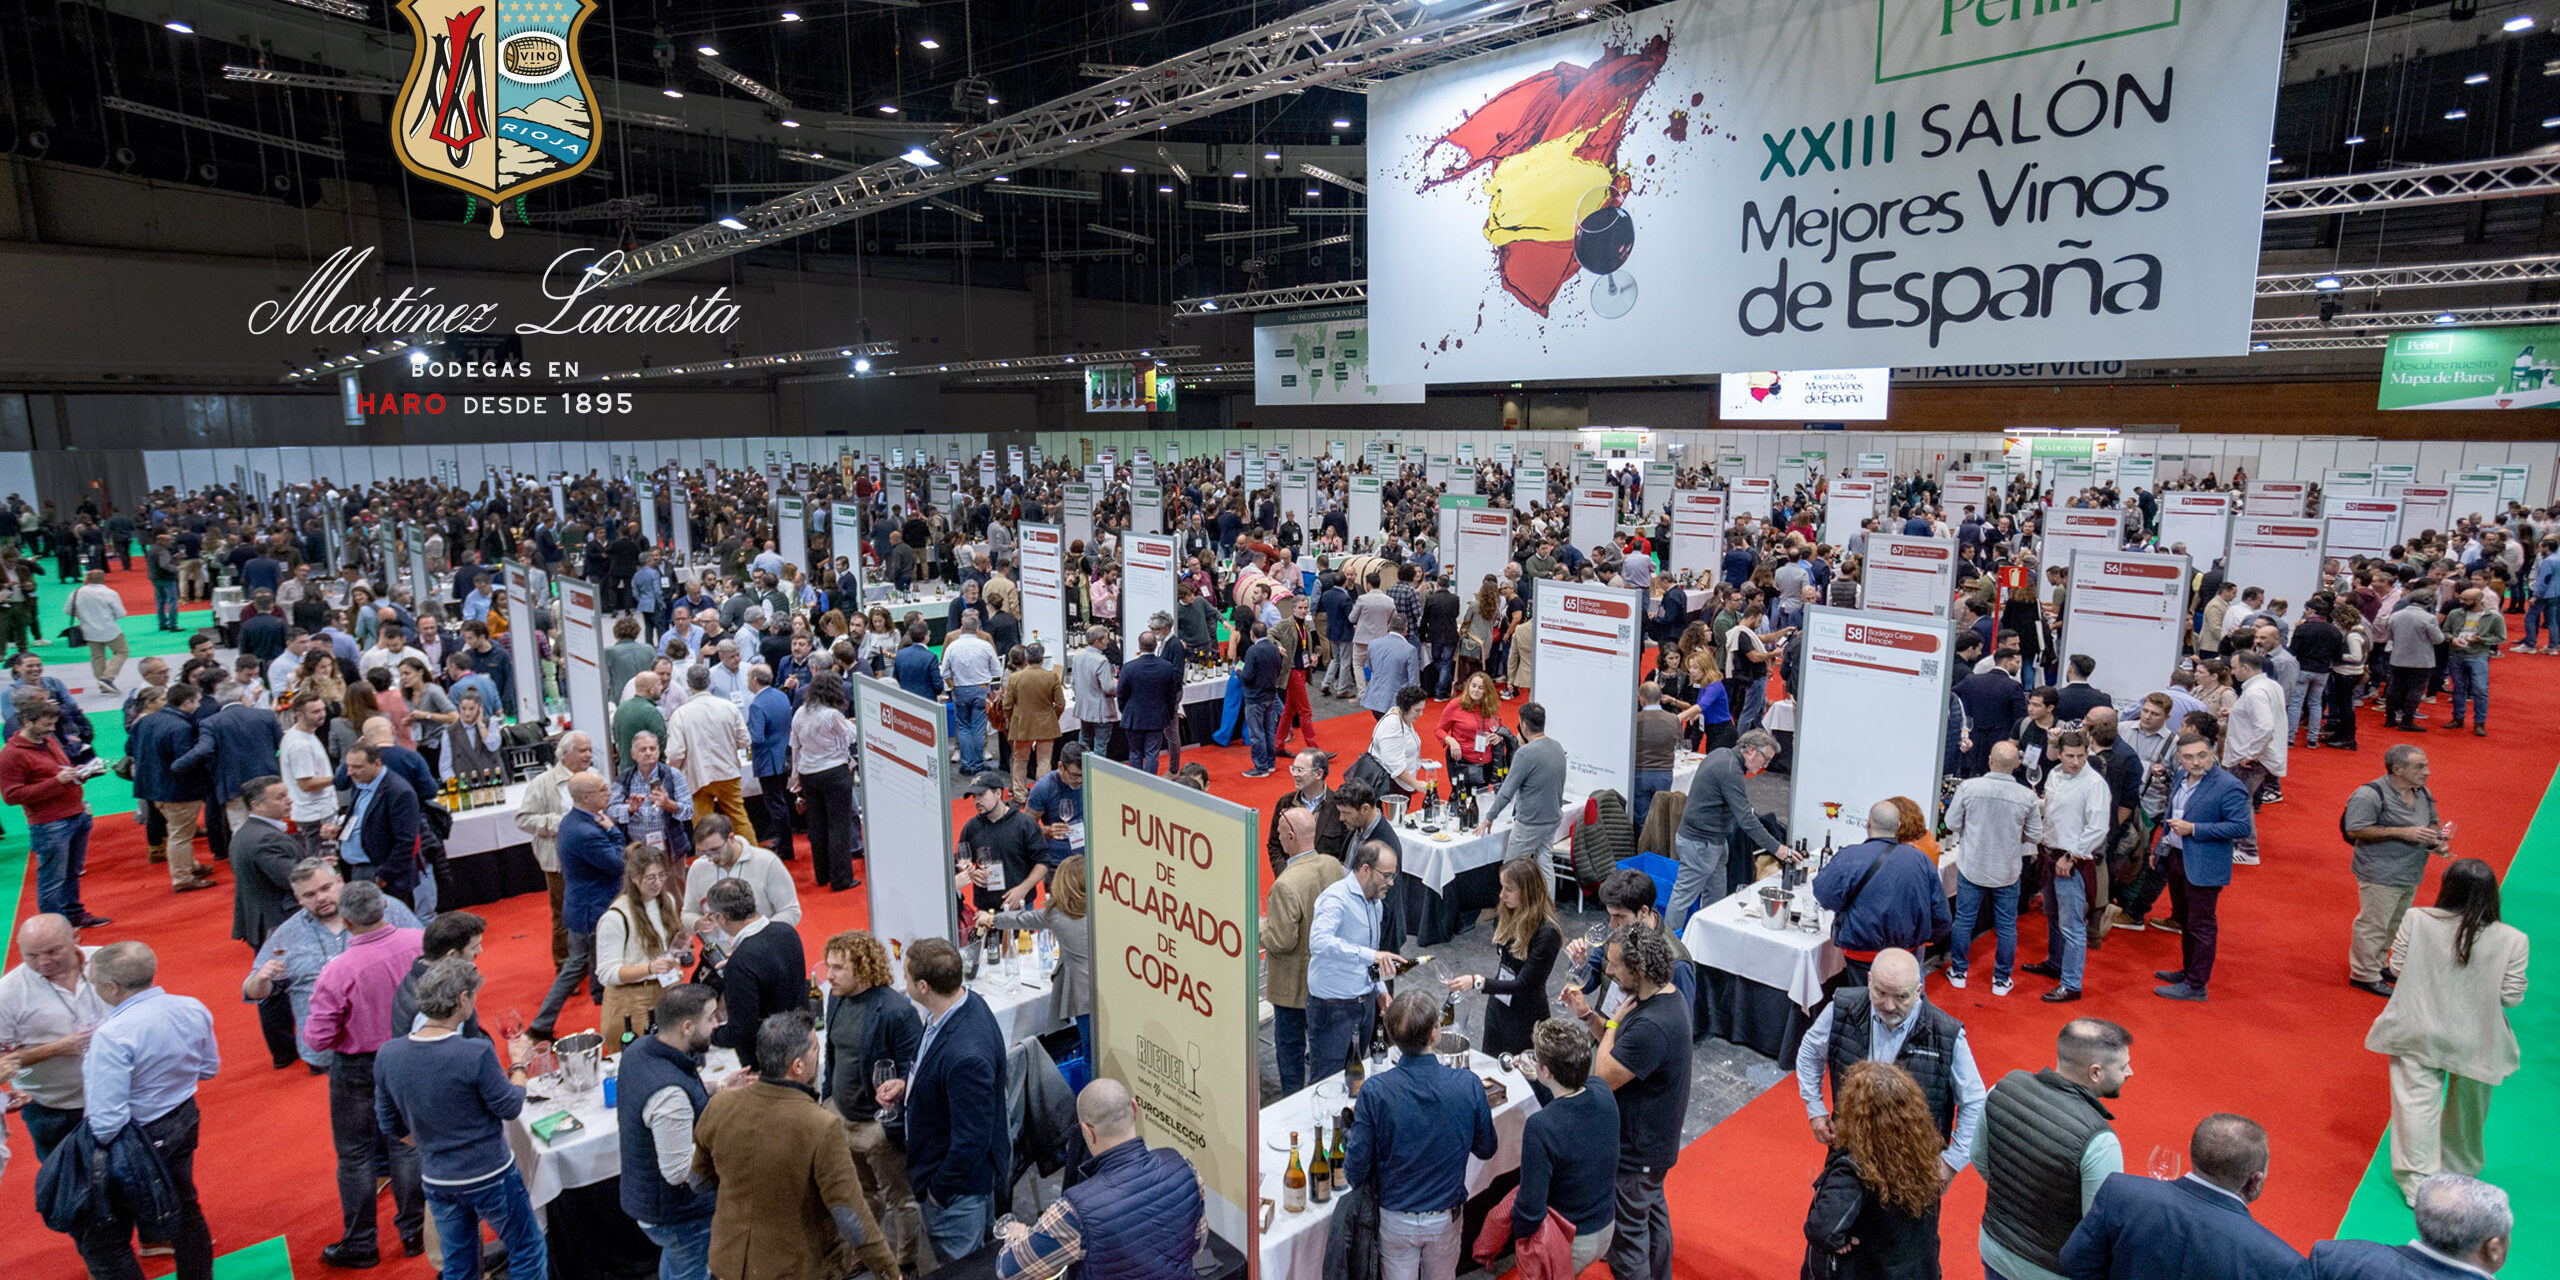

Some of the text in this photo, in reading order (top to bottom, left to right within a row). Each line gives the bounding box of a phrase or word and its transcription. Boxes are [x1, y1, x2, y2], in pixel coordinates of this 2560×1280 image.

[1760, 60, 2173, 181] XXIII SALÓN
[1742, 162, 2169, 263] Mejores Vinos
[1738, 239, 2162, 348] de España
[2392, 359, 2498, 371] Descubre nuestro
[2390, 371, 2495, 387] Mapa de Bares
[1805, 391, 1863, 405] de España
[2067, 516, 2077, 524] 69
[2259, 526, 2270, 535] 54
[1892, 546, 1902, 554] 67
[2105, 564, 2118, 573] 56
[1565, 599, 1576, 610] 65
[1847, 627, 1914, 641] 58 Bodega César
[1813, 646, 1836, 656] Bodega
[882, 708, 892, 725] 63
[1122, 803, 1213, 870] PUNTO
[1157, 861, 1176, 887] DE
[1099, 866, 1242, 958] ACLARADO
[1158, 933, 1177, 959] DE
[1126, 945, 1213, 1017] COPAS
[1137, 1035, 1187, 1089] RIEDEL
[1135, 1095, 1206, 1148] EUROSELECCIÓ
